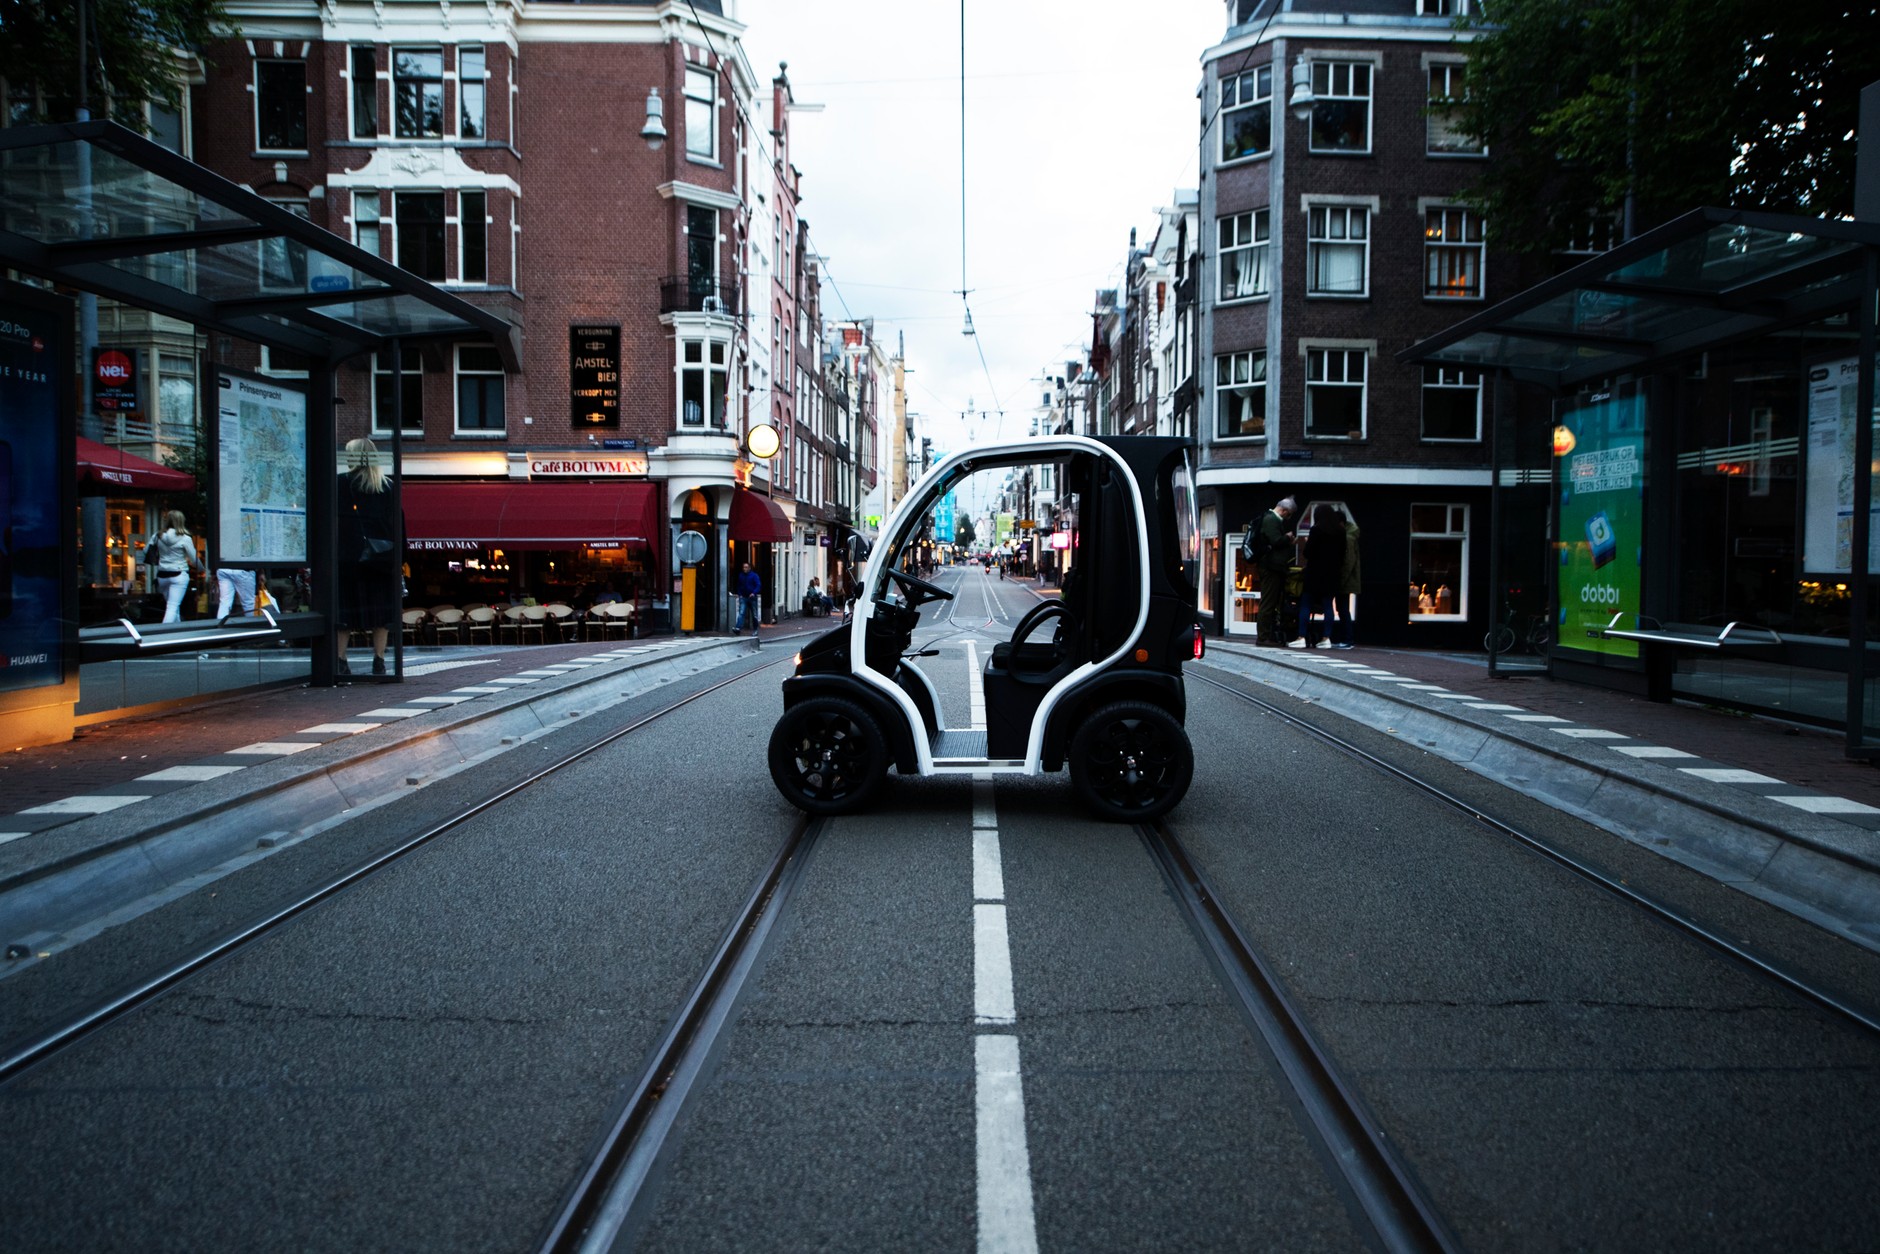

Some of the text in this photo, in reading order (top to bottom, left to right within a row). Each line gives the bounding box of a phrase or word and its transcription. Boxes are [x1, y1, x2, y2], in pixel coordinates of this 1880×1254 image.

[14, 323, 31, 338] Pro
[17, 368, 47, 383] YEAR
[597, 371, 617, 382] BIER
[238, 381, 282, 400] Prinsengracht
[574, 388, 603, 397] VERKOOPT
[1573, 447, 1633, 466] MET EEN DRUK OP
[531, 460, 643, 473] Café BOUWMAN
[1608, 461, 1636, 475] KLEREN
[1575, 476, 1630, 493] LATEN STRIJKEN
[425, 541, 478, 550] BOUWMAN
[1581, 583, 1620, 604] dobbi
[10, 653, 48, 666] HUAWEI
